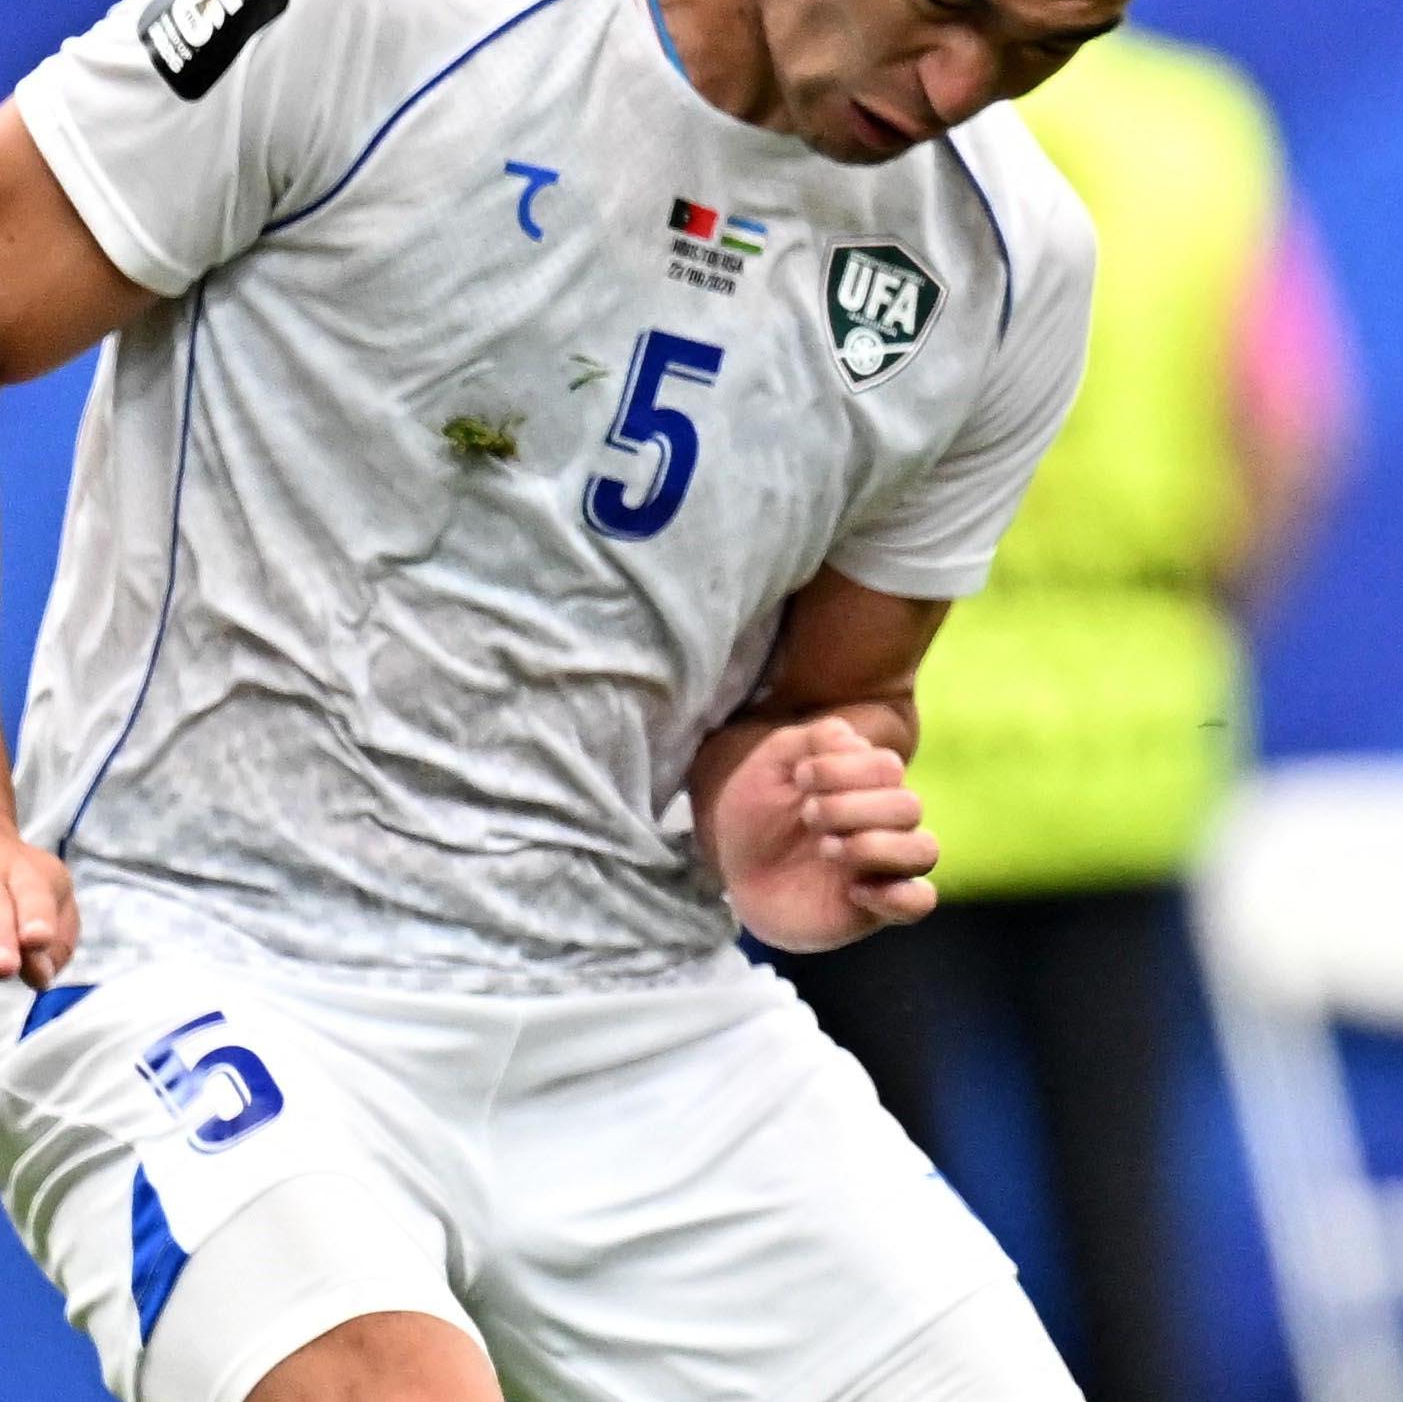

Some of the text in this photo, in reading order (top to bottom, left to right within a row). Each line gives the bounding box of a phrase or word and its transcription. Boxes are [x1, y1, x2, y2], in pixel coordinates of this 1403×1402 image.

[837, 262, 920, 336] UFA
[582, 329, 727, 542] 5
[135, 1010, 284, 1154] 5
